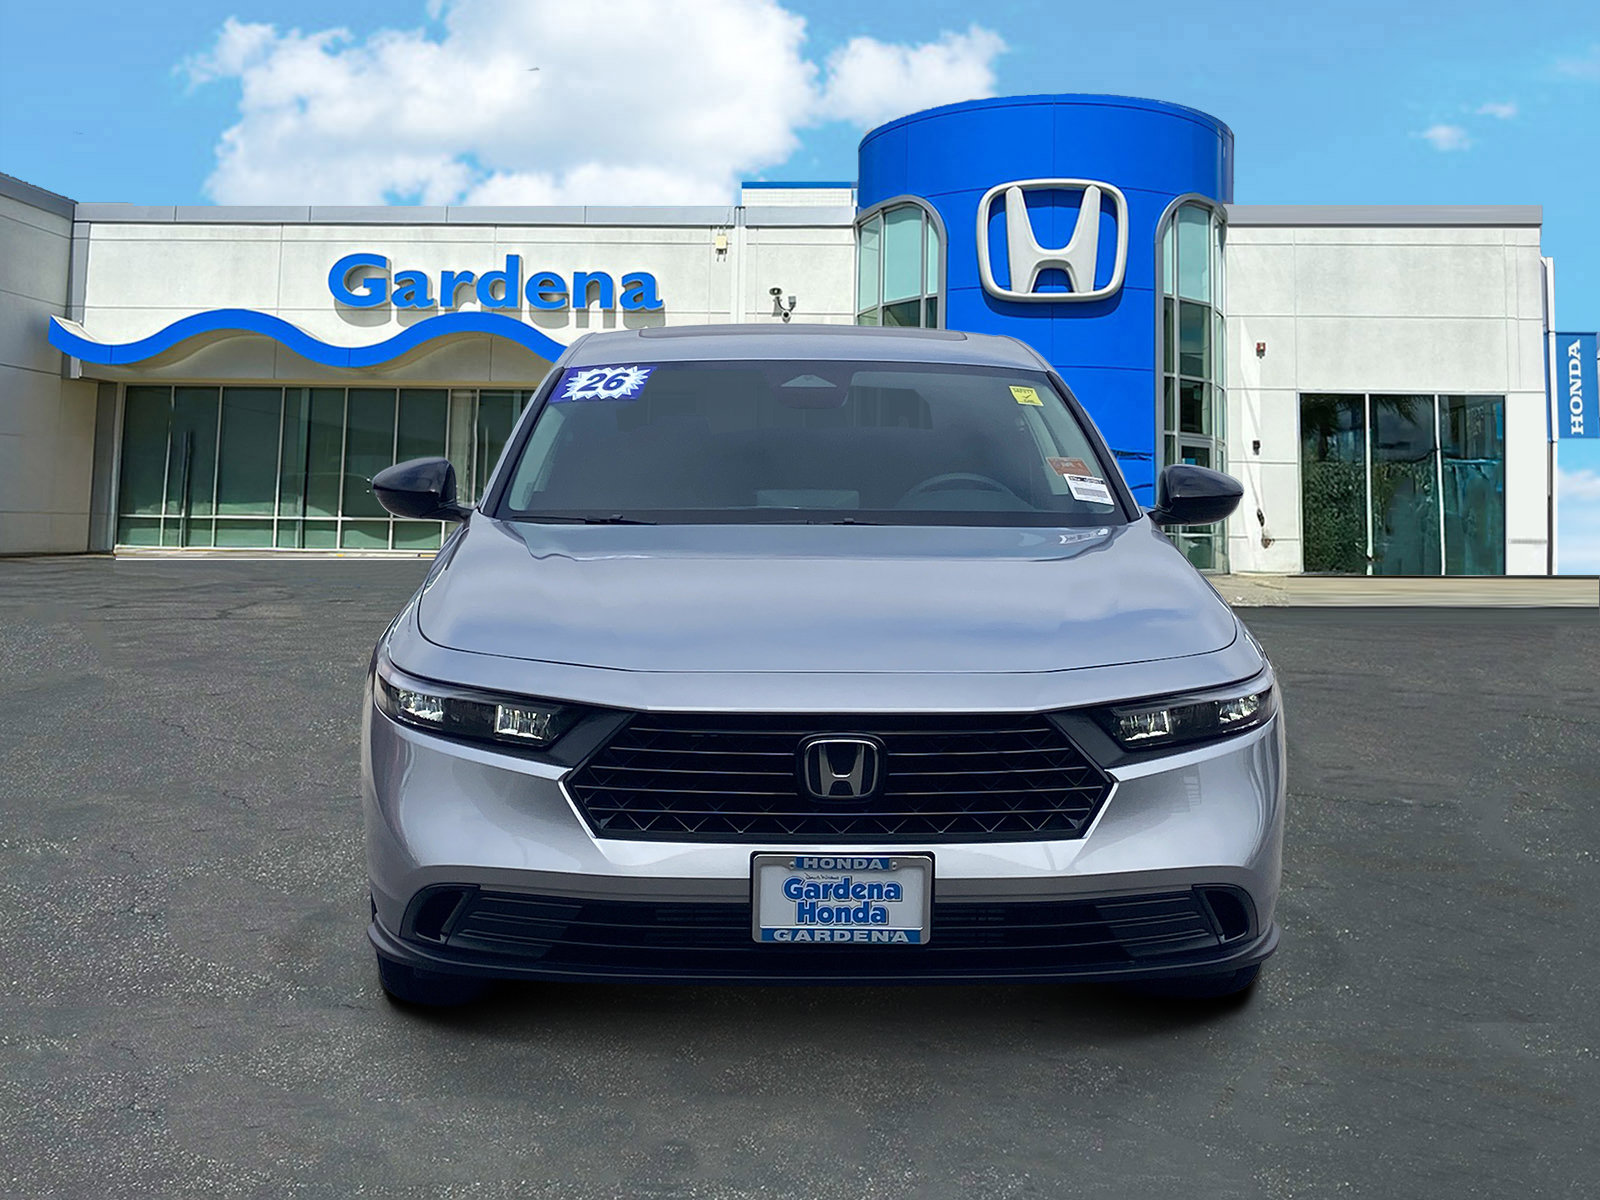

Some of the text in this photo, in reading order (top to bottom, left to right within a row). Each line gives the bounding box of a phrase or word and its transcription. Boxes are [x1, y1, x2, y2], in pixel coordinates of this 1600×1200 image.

[328, 252, 664, 310] Gardena
[576, 372, 631, 392] 26
[1568, 339, 1584, 435] HONDA
[803, 857, 883, 870] HONDA
[783, 875, 903, 901] Gardena
[796, 900, 888, 924] Honda
[773, 930, 909, 942] GARDENA
